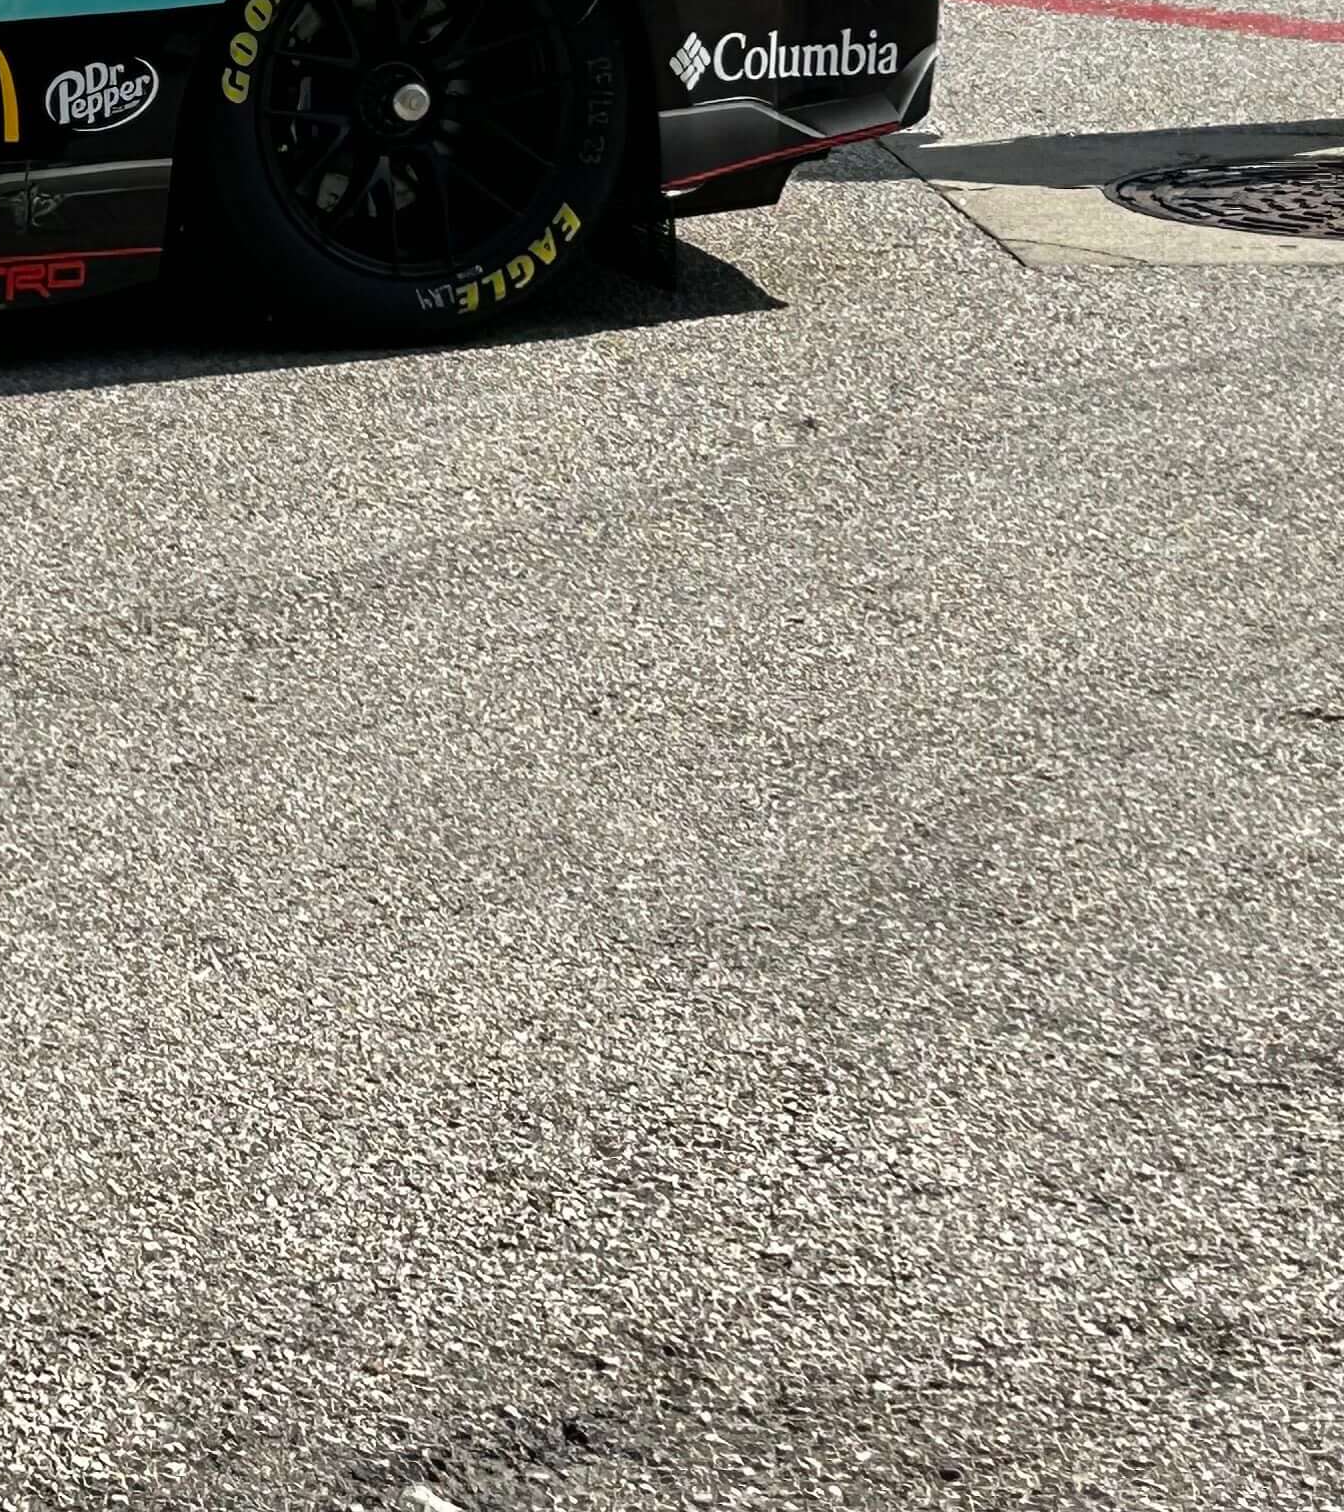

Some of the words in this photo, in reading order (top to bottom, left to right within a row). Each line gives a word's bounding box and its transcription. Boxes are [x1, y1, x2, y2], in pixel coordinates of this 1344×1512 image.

[84, 62, 125, 87] Dr
[713, 28, 899, 82] Columbia
[58, 70, 151, 125] Pepper
[456, 202, 582, 316] EAGLE
